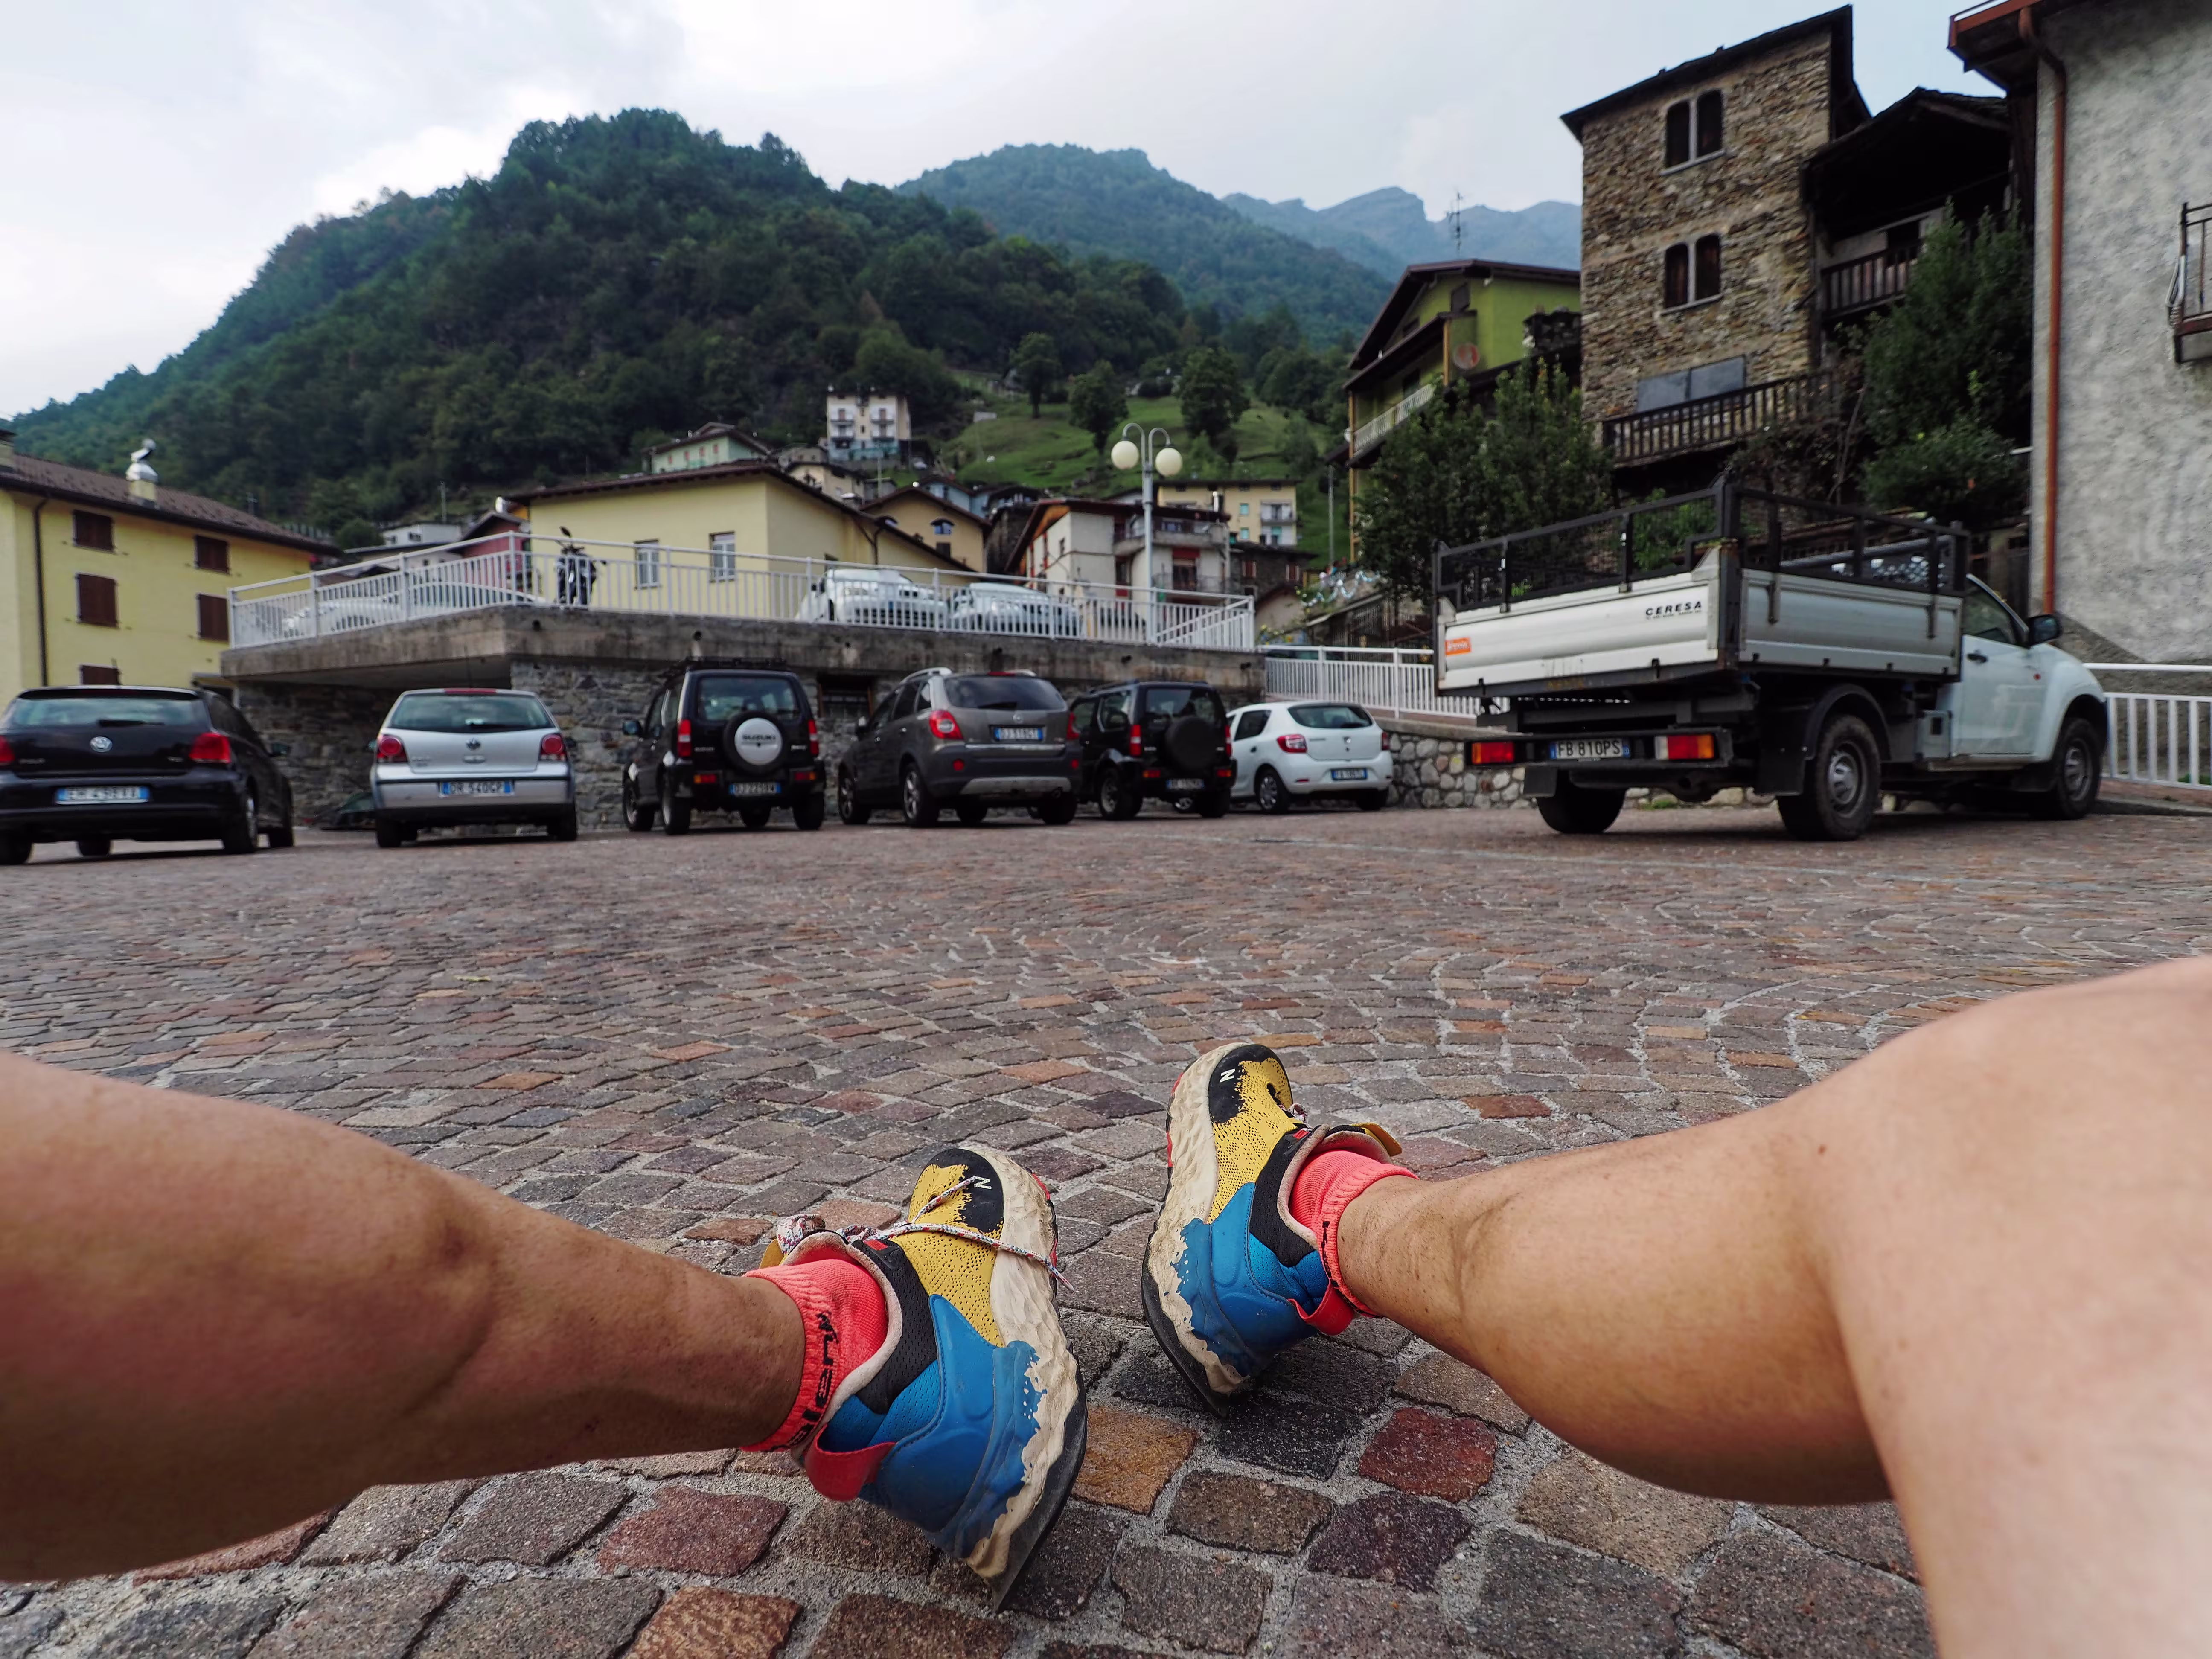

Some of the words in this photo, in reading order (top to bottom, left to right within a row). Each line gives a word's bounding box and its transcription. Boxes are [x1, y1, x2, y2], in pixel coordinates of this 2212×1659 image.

[1645, 601, 1702, 616] CERESA
[1558, 742, 1573, 756] FB
[1578, 739, 1620, 755] 810PS
